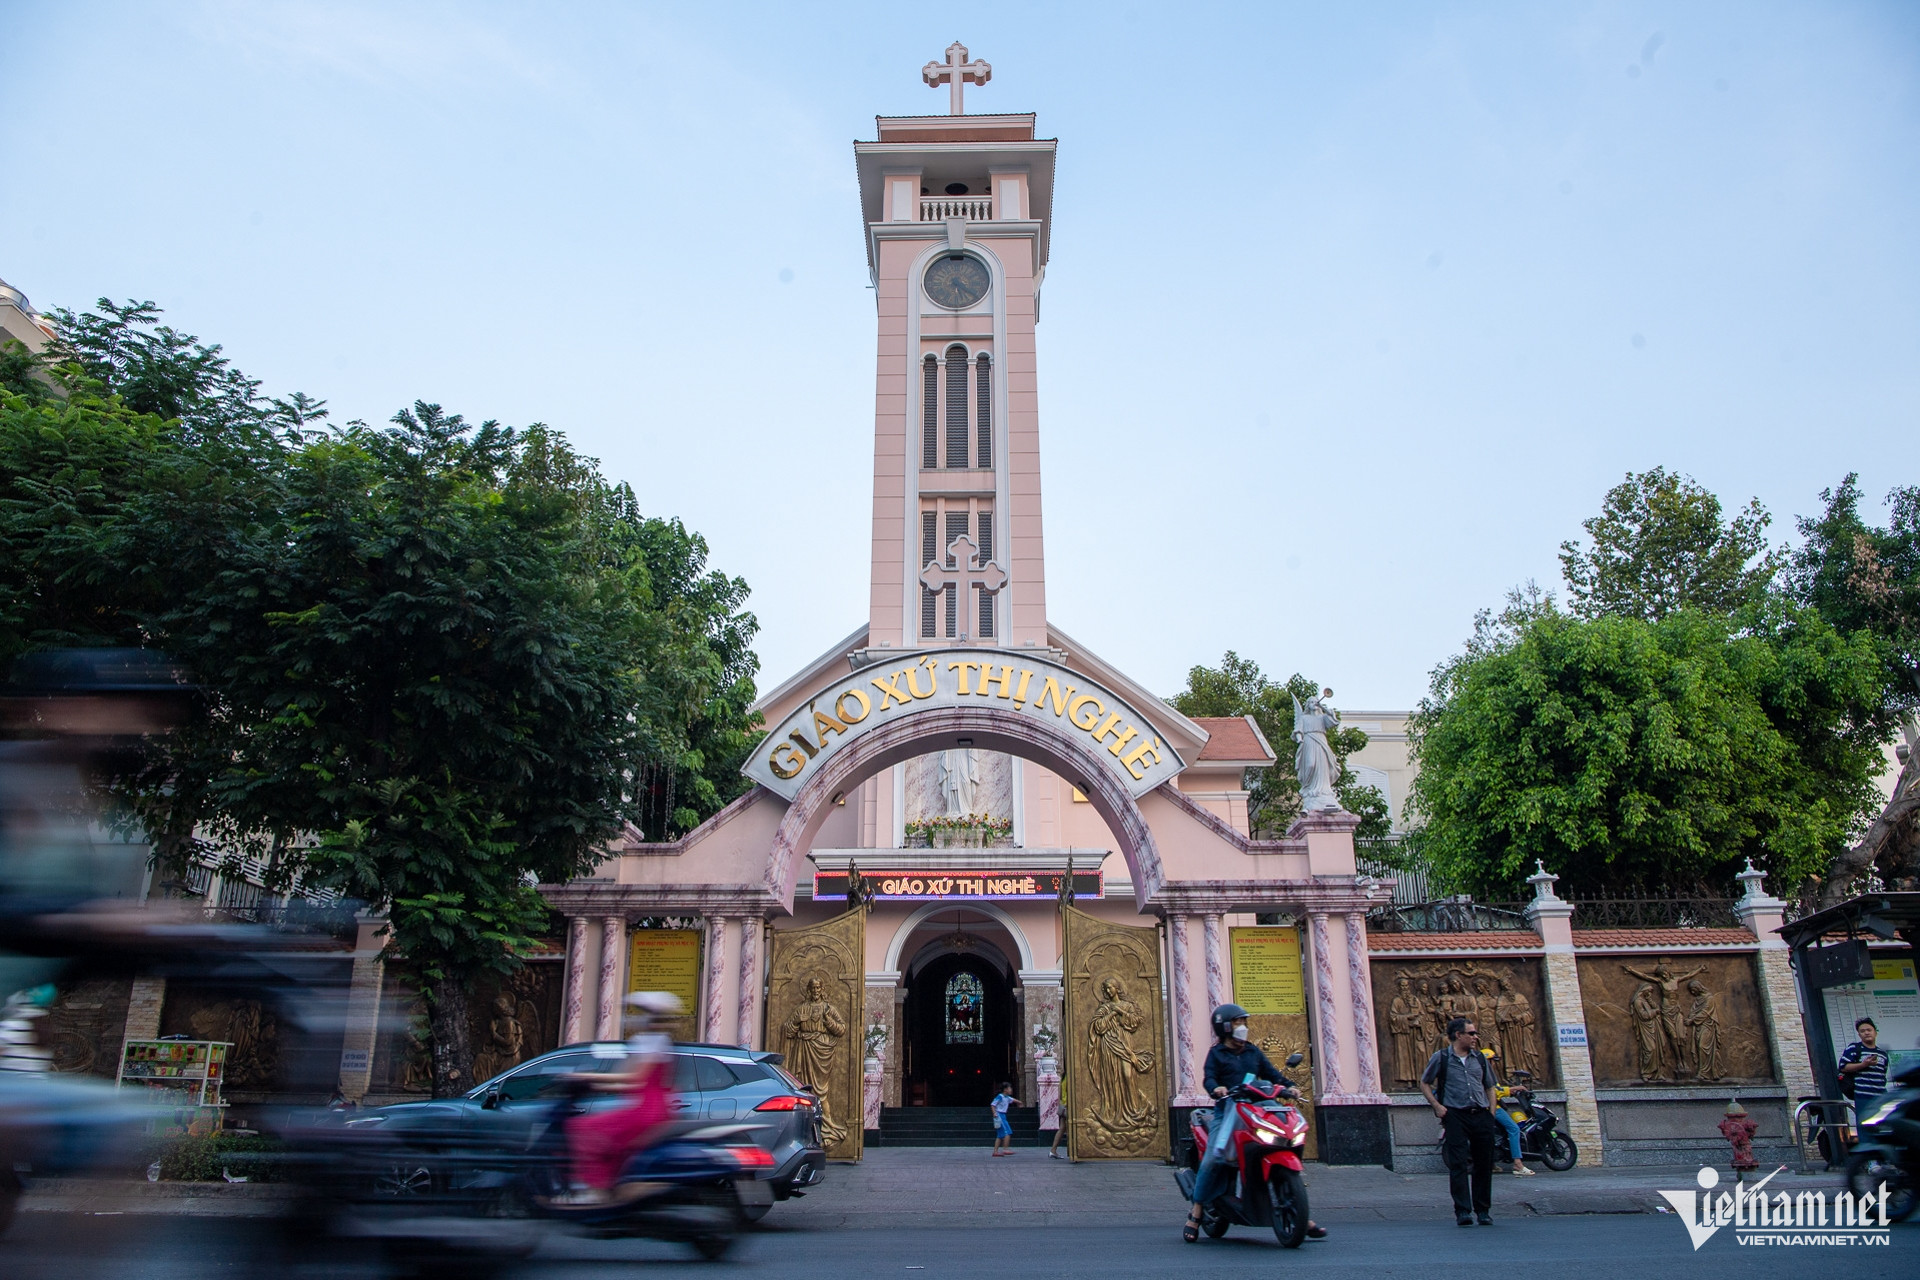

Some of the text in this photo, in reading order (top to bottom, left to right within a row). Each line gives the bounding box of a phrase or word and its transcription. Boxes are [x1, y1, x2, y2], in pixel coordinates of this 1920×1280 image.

[769, 655, 1162, 780] GIÁO XỨ THỊ NGHÈ
[882, 876, 1036, 896] GIÁO XỨ THỊ NGHÈ
